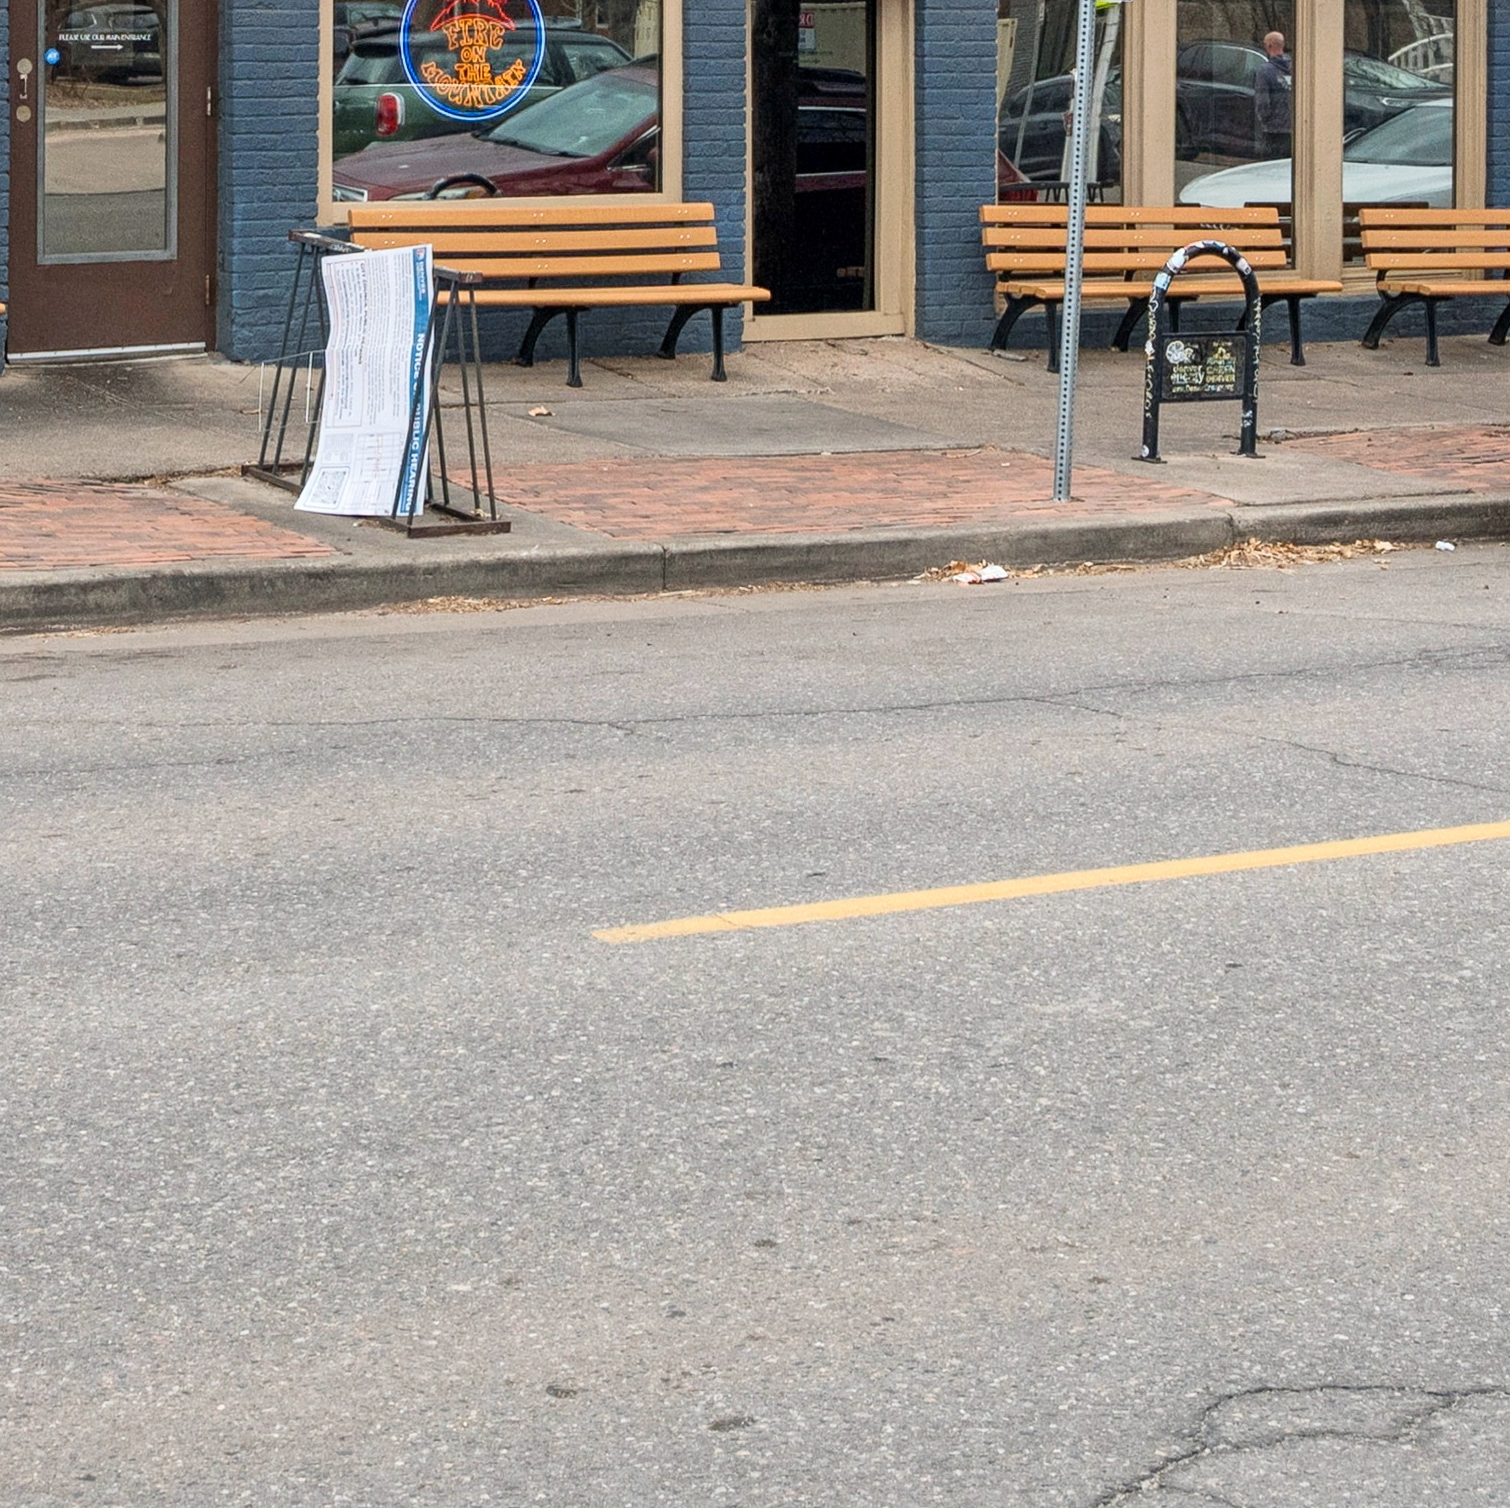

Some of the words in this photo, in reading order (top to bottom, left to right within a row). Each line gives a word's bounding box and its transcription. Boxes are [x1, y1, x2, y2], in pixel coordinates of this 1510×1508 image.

[120, 33, 151, 41] ENTRANCE
[443, 18, 506, 51] FIRE
[460, 45, 486, 63] ON
[420, 58, 527, 108] MOUNTAIN
[455, 63, 491, 83] THE
[413, 333, 425, 379] NOTICE
[405, 452, 420, 511] HEARING
